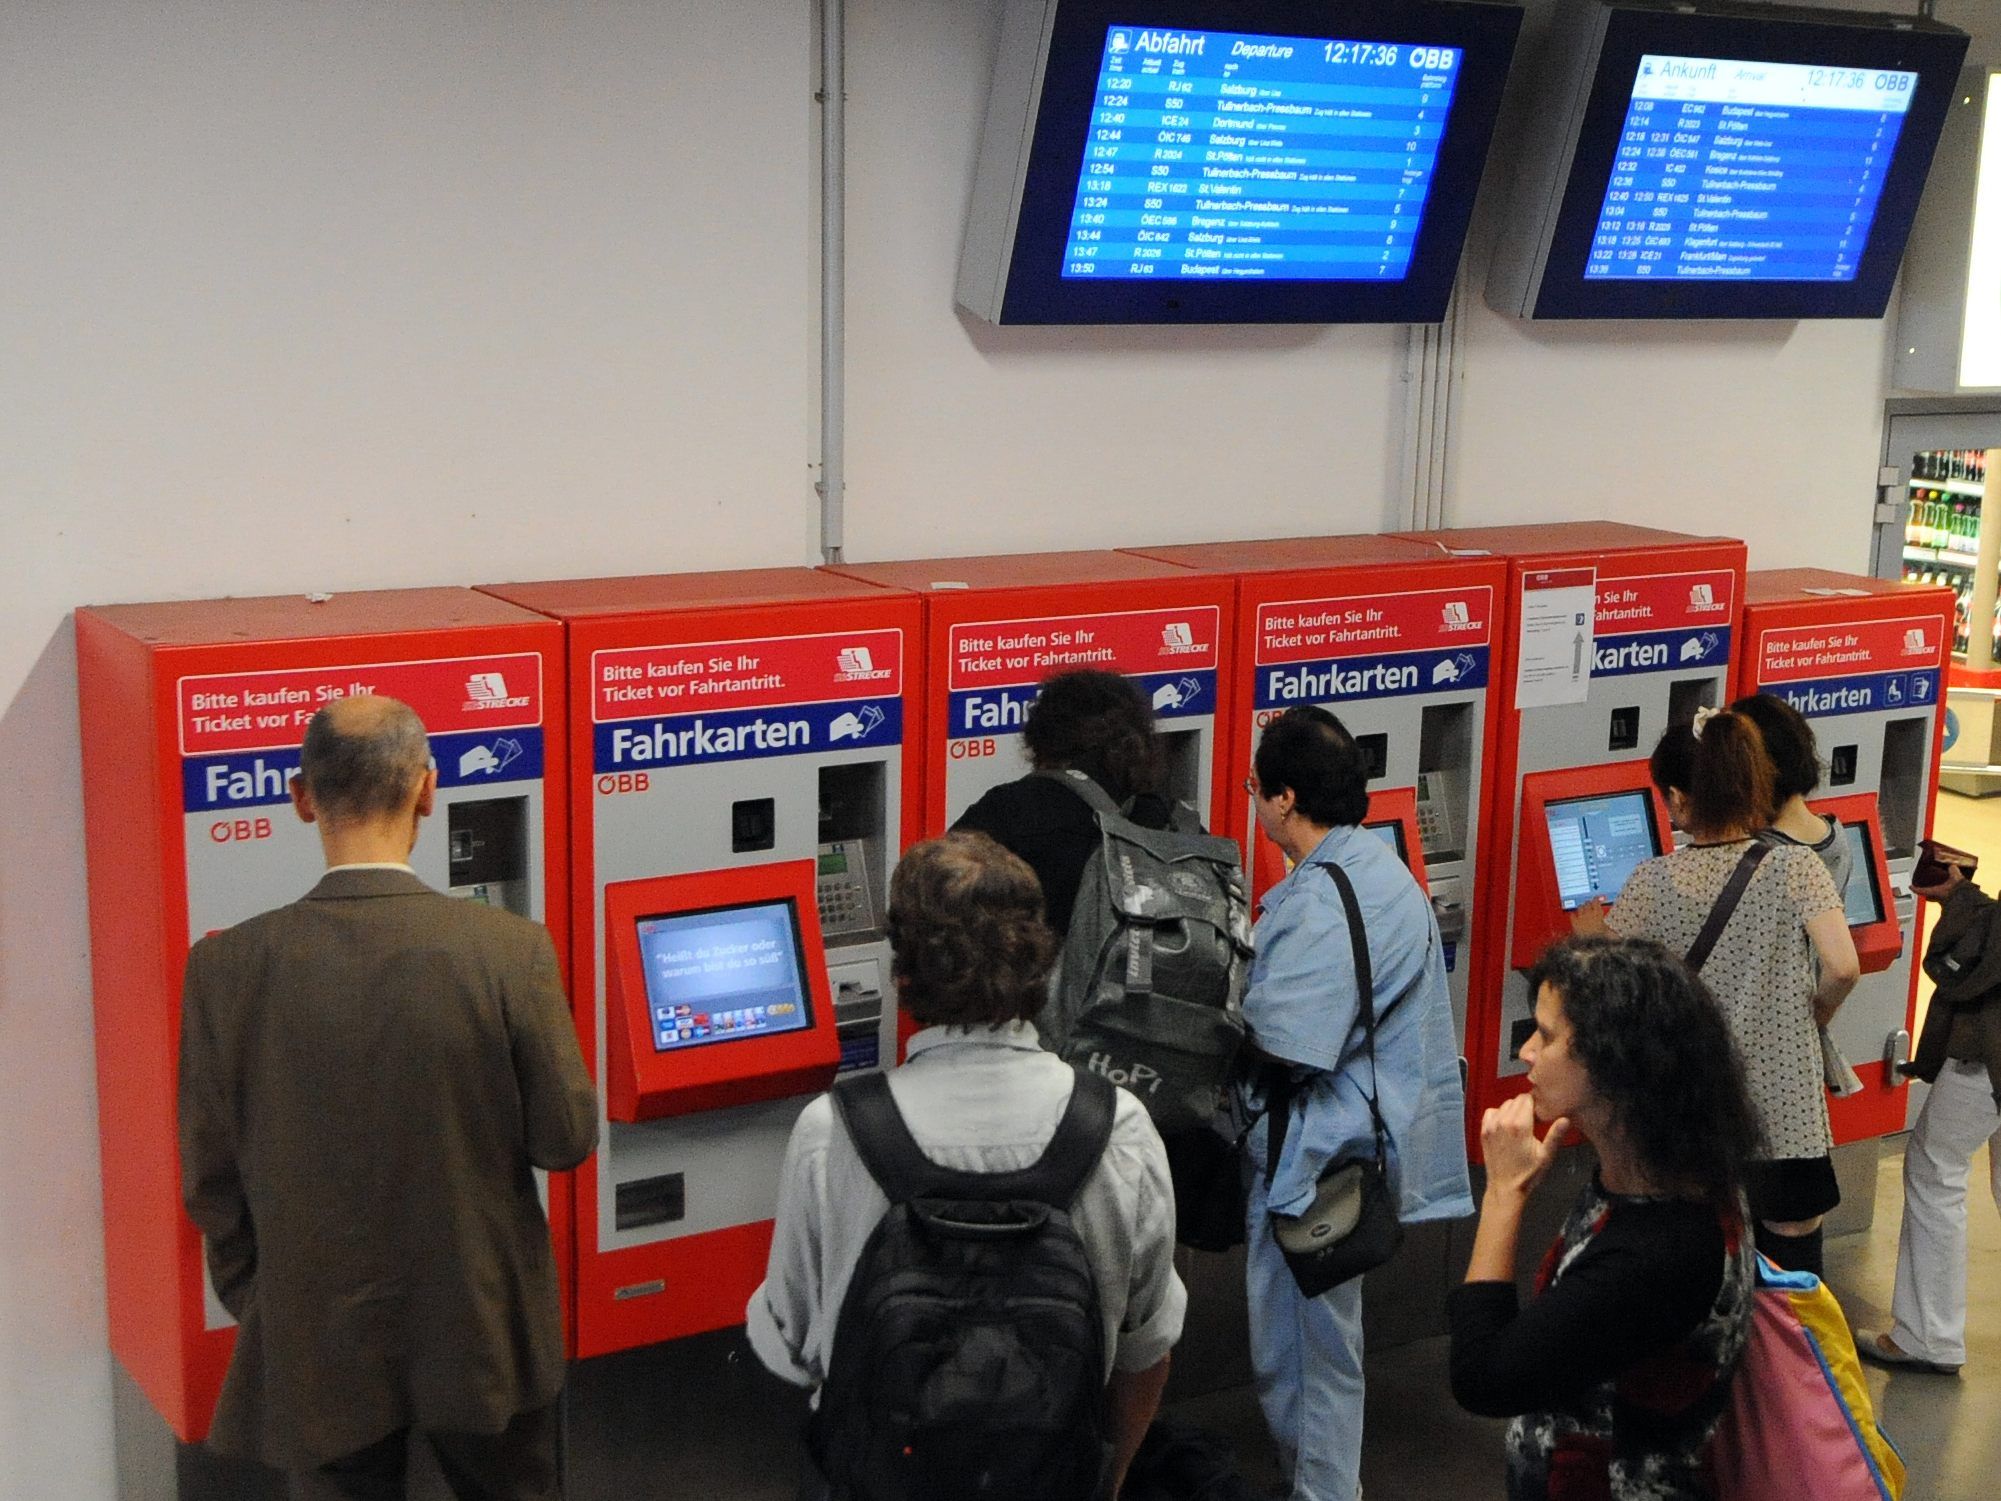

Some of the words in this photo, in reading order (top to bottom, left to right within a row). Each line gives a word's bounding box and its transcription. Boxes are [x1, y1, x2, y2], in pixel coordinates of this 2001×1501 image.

[1135, 31, 1206, 55] Abfahrt
[1231, 41, 1293, 59] Departure
[1324, 43, 1398, 66] 12:17:36
[1660, 61, 1717, 80] Ankunft
[1807, 70, 1866, 89] 12:17:36
[1105, 78, 1131, 89] 12:20
[1218, 83, 1257, 97] Salzburg
[1102, 95, 1128, 107] 12:24
[1164, 98, 1184, 109] S50
[1416, 110, 1424, 119] 4
[1098, 112, 1124, 124] 12:40
[1160, 115, 1178, 126] ICE
[1177, 116, 1190, 127] 24
[1211, 117, 1254, 129] Dortmund
[1095, 129, 1121, 141] 12:44
[1207, 134, 1246, 147] Salzburg
[1404, 141, 1416, 151] 10
[1092, 146, 1118, 157] 12:47
[1153, 149, 1162, 159] R
[1405, 158, 1411, 166] 1
[1089, 163, 1114, 174] 12:54
[1150, 165, 1170, 176] S50
[1146, 182, 1168, 192] REX
[1082, 197, 1108, 207] 13:24
[1143, 198, 1163, 209] S50
[1079, 214, 1104, 224] 13:40
[1190, 216, 1226, 228] Bregenz
[1076, 230, 1101, 240] 13:44
[1186, 232, 1224, 244] Salzburg
[1073, 246, 1098, 256] 13:47
[1133, 247, 1142, 257] R
[1070, 263, 1095, 273] 13:50
[1130, 263, 1143, 273] RJ
[1179, 264, 1220, 275] Budapest
[1377, 265, 1385, 274] 7
[1604, 591, 1620, 604] Sie
[1623, 589, 1639, 602] Ihr
[1264, 616, 1295, 631] Bitte
[1298, 612, 1341, 628] kaufen
[1344, 610, 1364, 624] Sie
[1366, 608, 1384, 621] Ihr
[958, 638, 994, 654] Bitte
[996, 634, 1046, 650] kaufen
[1050, 632, 1072, 646] Sie
[1075, 629, 1095, 644] Ihr
[1264, 634, 1302, 649] Ticket
[1304, 633, 1326, 646] vor
[1329, 624, 1402, 643] Fahrtantritt.
[1766, 642, 1790, 654] Bitte
[1792, 638, 1826, 651] kaufen
[1828, 637, 1842, 648] Sie
[1844, 635, 1859, 646] Ihr
[958, 656, 1002, 673] Ticket
[1006, 655, 1029, 668] vor
[1032, 647, 1117, 667] Fahrtantritt.
[1591, 642, 1668, 671] karten
[1766, 657, 1795, 670] Ticket
[1797, 656, 1813, 666] vor
[1815, 650, 1872, 664] Fahrtantritt.
[602, 664, 642, 682] Bitte
[647, 660, 704, 678] kaufen
[708, 658, 732, 674] Sie
[737, 655, 760, 671] Ihr
[602, 685, 654, 702] Ticket
[658, 682, 685, 698] vor
[688, 674, 786, 695] Fahrtantritt.
[1268, 663, 1418, 701] Fahrkarten
[192, 692, 238, 712] Bitte
[244, 687, 310, 708] kaufen
[316, 684, 344, 702] Sie
[349, 682, 376, 698] Ihr
[1785, 687, 1872, 713] hrkarten
[964, 692, 1035, 730] Fahr
[1256, 711, 1285, 729] ÖB
[191, 712, 252, 734] Ticket
[256, 712, 290, 729] vor
[612, 718, 811, 764] Fahrkarten
[950, 738, 996, 760] ÖBB
[206, 758, 303, 802] Fahr
[597, 773, 650, 796] ÖBB
[210, 817, 273, 843] ÖBB
[696, 948, 711, 960] du
[712, 944, 749, 956] Zucker
[751, 940, 777, 952] oder
[662, 965, 702, 978] warum
[704, 961, 724, 972] bist
[726, 959, 741, 968] du
[744, 958, 757, 967] so
[1088, 1051, 1164, 1094] HoPi
